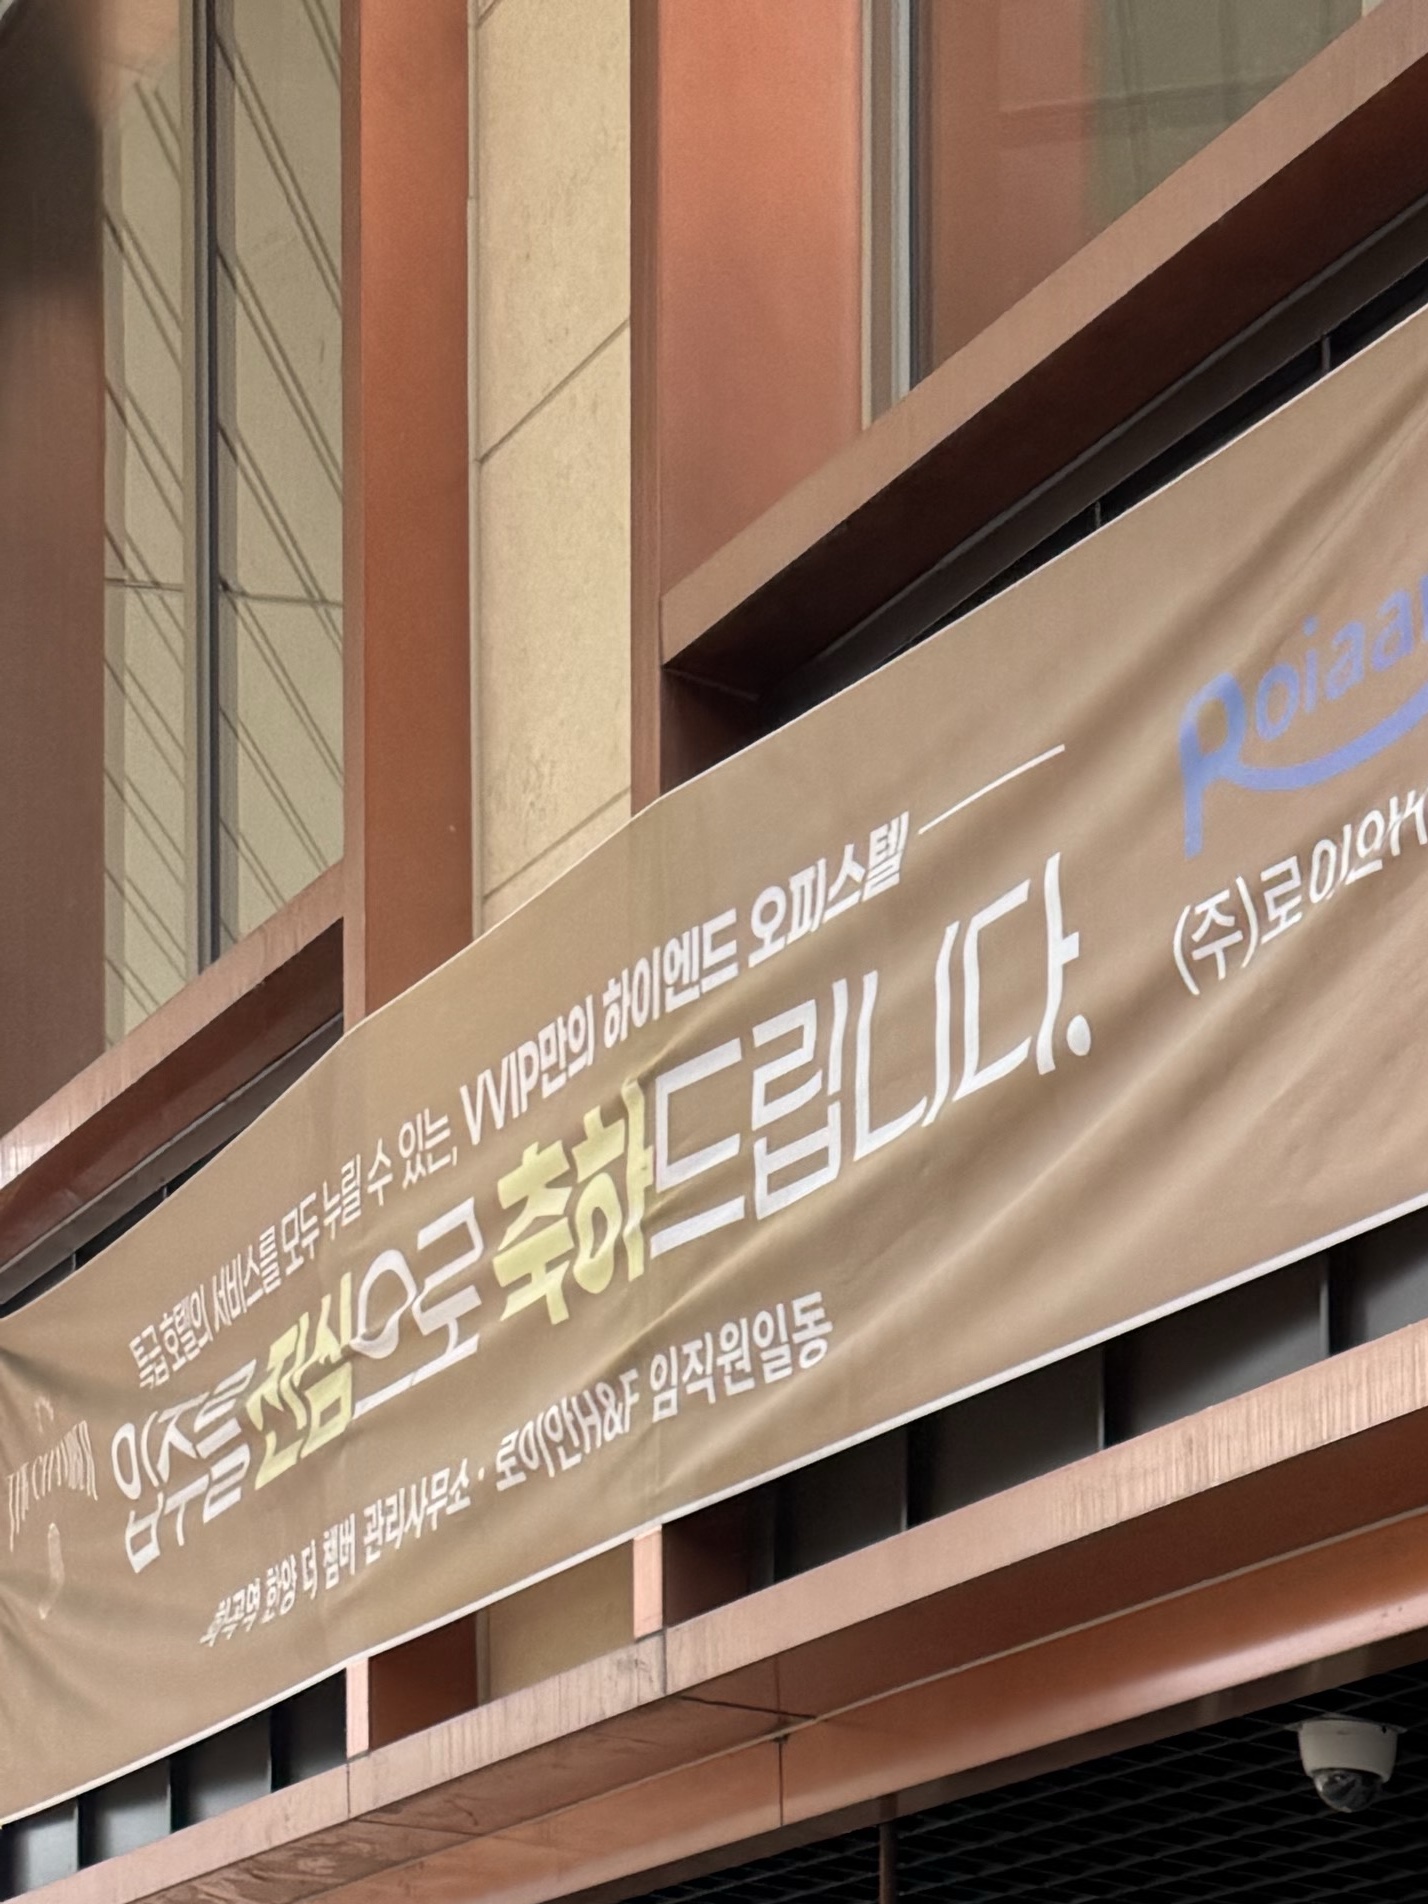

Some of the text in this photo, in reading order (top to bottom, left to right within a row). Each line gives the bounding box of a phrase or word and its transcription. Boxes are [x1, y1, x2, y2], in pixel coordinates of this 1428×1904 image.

[111, 851, 1092, 1574] 입주를 진심으로 축하드립니다.
[129, 1284, 213, 1390] 특급호텔의
[212, 1225, 282, 1333] 서비스를
[281, 1193, 320, 1276] 모두
[322, 1153, 362, 1241] 누릴
[367, 1137, 393, 1207] 수
[460, 993, 596, 1146] VVIP만의
[602, 907, 739, 1049] 하이엔드
[747, 810, 911, 969] 오피스텔
[199, 1576, 262, 1648] 화곡역
[261, 1553, 298, 1624] 한양
[301, 1538, 318, 1600] 더
[363, 1457, 472, 1567] 관리사무소
[495, 1368, 641, 1492] 로이안H&F
[650, 1290, 834, 1424] 임직원일동
